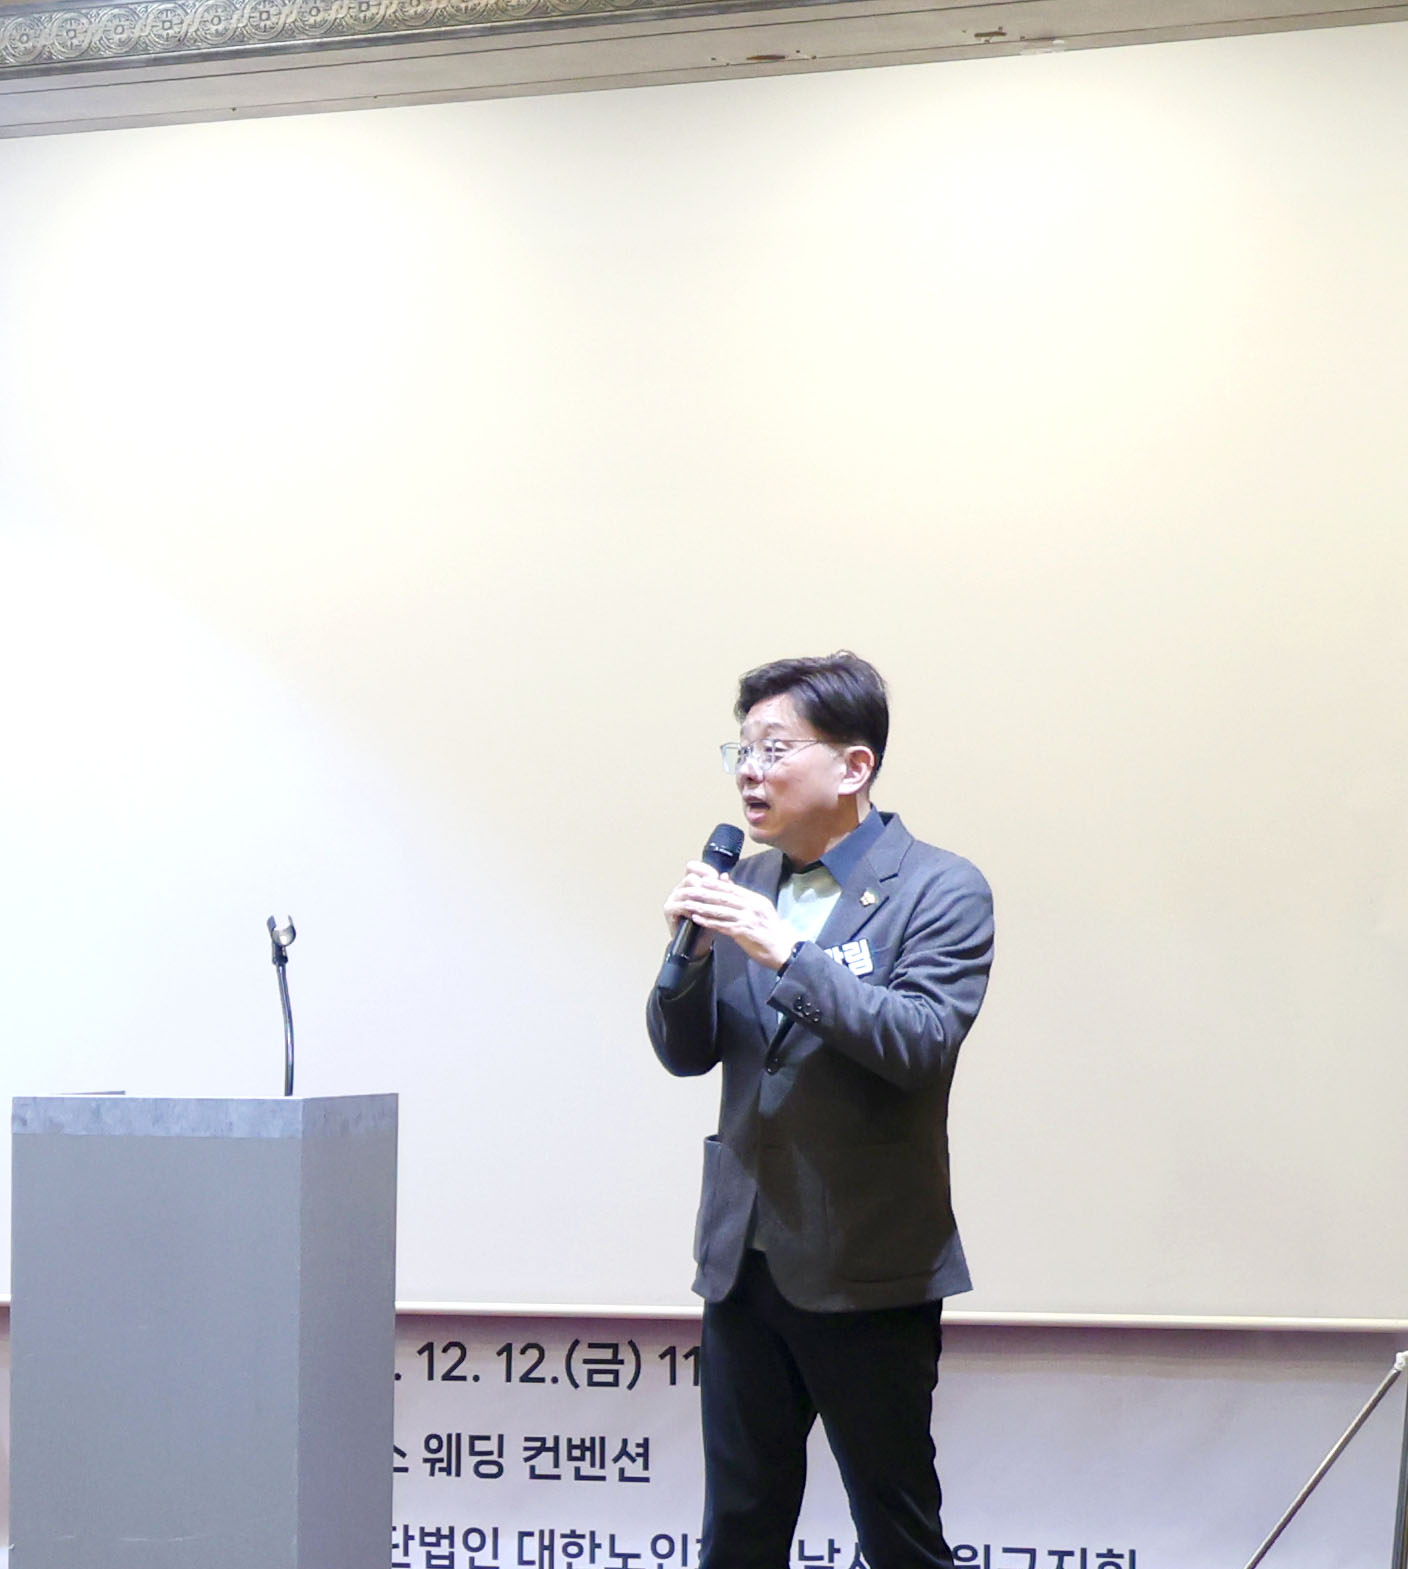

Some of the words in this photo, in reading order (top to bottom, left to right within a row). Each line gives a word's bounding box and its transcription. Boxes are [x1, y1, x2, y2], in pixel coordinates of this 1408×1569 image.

[417, 1340, 480, 1383] 12.
[496, 1338, 642, 1391] 12.(금)
[422, 1432, 505, 1479] 웨딩
[522, 1435, 651, 1484] 컨벤션
